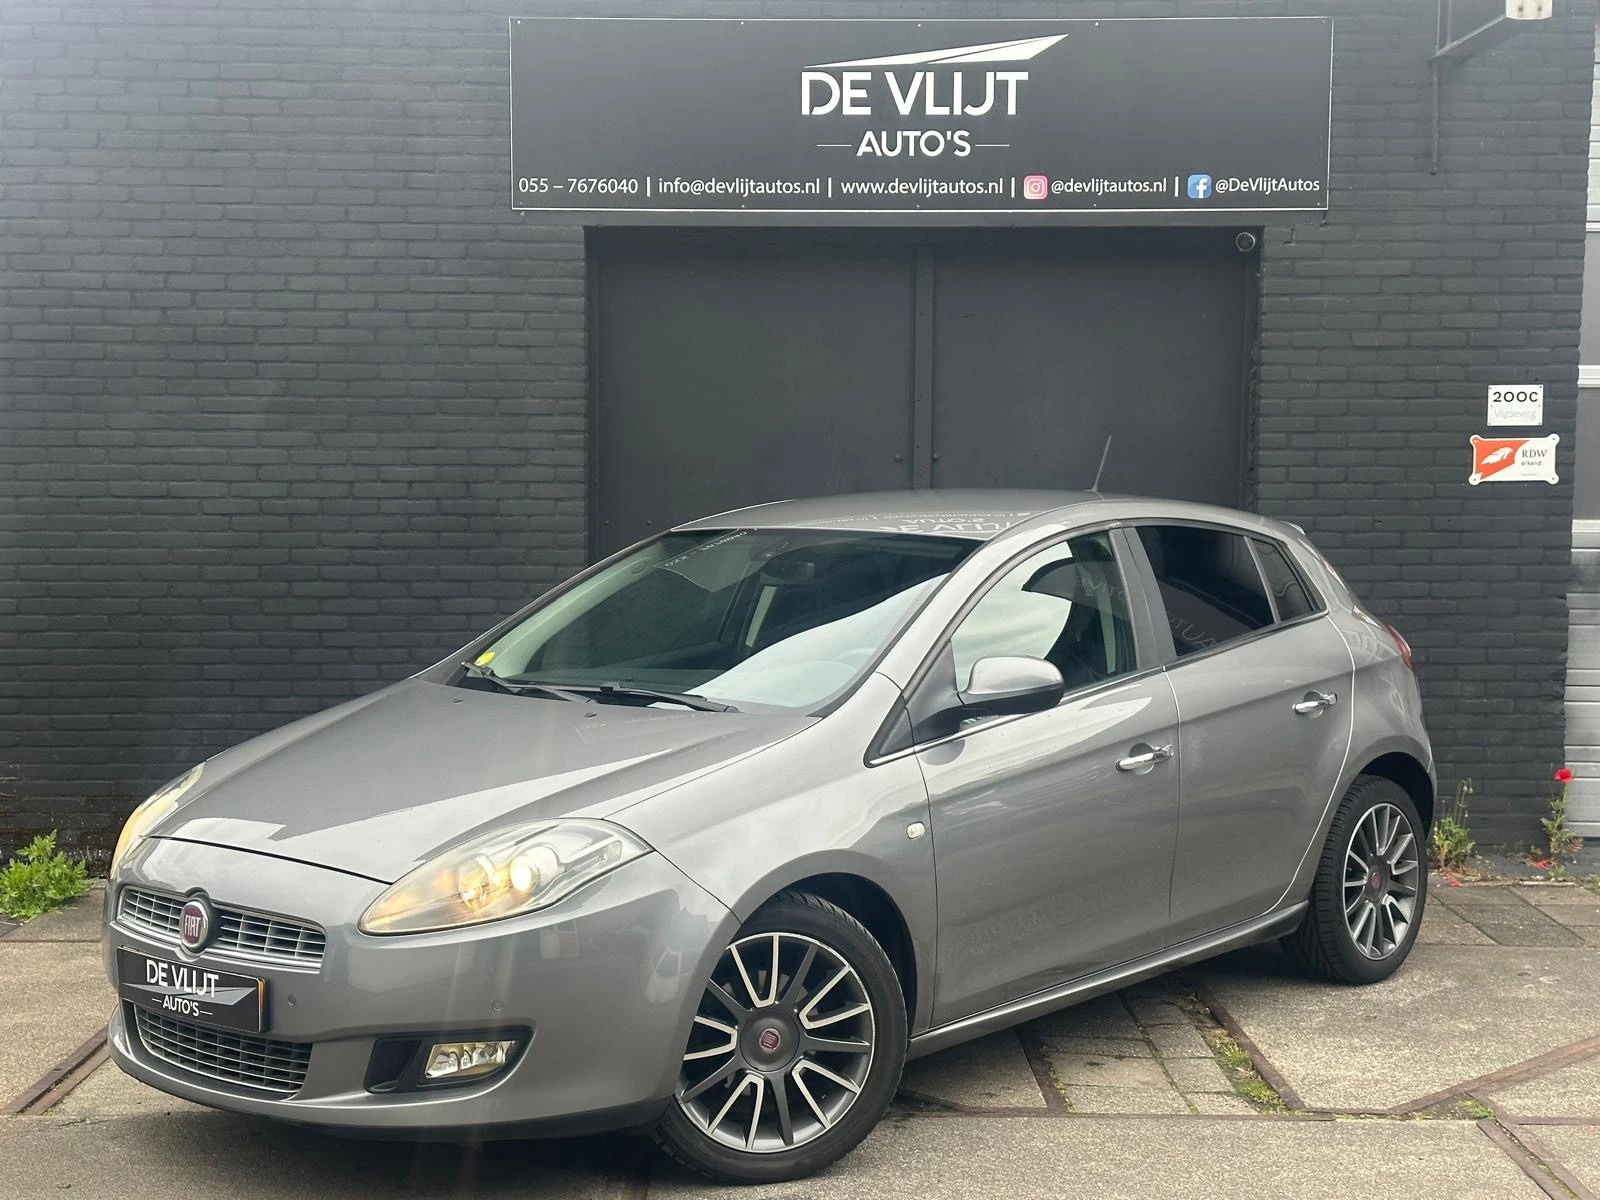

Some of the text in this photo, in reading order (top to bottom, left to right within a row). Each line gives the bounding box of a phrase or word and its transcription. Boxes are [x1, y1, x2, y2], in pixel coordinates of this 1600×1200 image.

[801, 71, 1029, 117] DE VLIJT
[855, 130, 972, 157] AUTO'S
[518, 177, 549, 194] 055
[567, 177, 639, 194] 7676040
[658, 177, 820, 198] info@devlijtautos.nl
[841, 177, 1003, 198] www.devlijtautos.nl
[1051, 176, 1167, 196] @devlijtautos.nl
[1215, 177, 1320, 195] @DeVlijtAutos
[1521, 448, 1548, 459] RDW
[184, 914, 202, 938] FIAT
[146, 959, 219, 998] DE VLIJT
[162, 994, 200, 1017] AUTO'S
